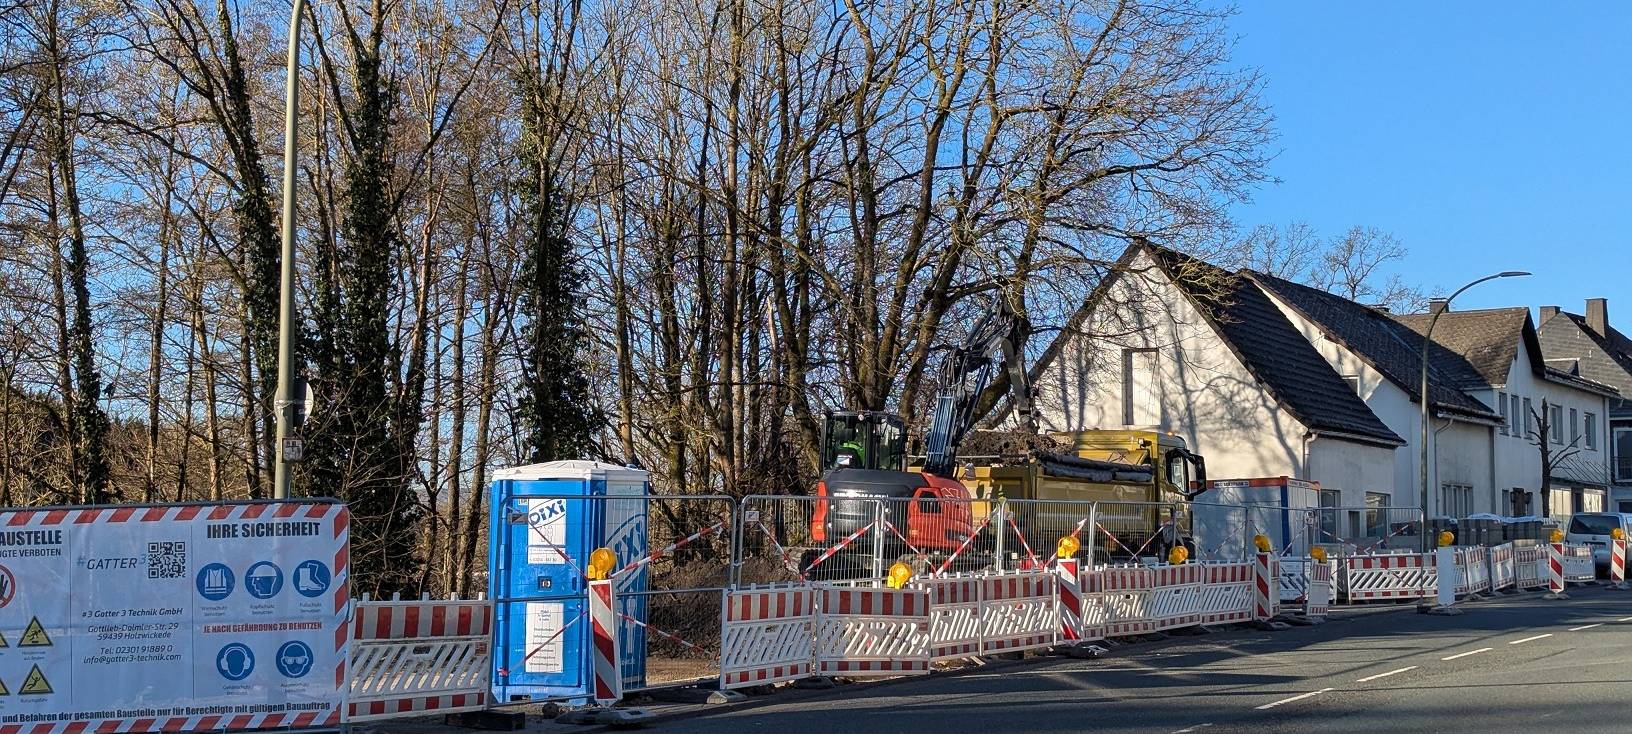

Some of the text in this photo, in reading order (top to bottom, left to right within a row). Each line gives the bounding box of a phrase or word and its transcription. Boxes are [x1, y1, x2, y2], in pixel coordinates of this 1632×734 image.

[207, 522, 321, 539] IHRE SICHERHEIT
[19, 548, 61, 557] VERBOTEN
[94, 610, 120, 618] Gatter
[128, 608, 158, 616] Technik
[159, 607, 183, 616] GmbH
[168, 622, 178, 630] 29
[204, 625, 211, 633] JE
[212, 624, 231, 633] NACH
[279, 622, 288, 631] ZU
[288, 622, 322, 631] BENUTZEN
[97, 631, 172, 641] 59439 Holzwickede
[115, 646, 140, 654] 02301
[141, 645, 166, 654] 91889
[83, 653, 182, 665] info@gatter3-technik.com
[2, 701, 331, 723] und Befahren der gesamten Baustelle nur für Berechtigte mit gültigem Bauauftrag
